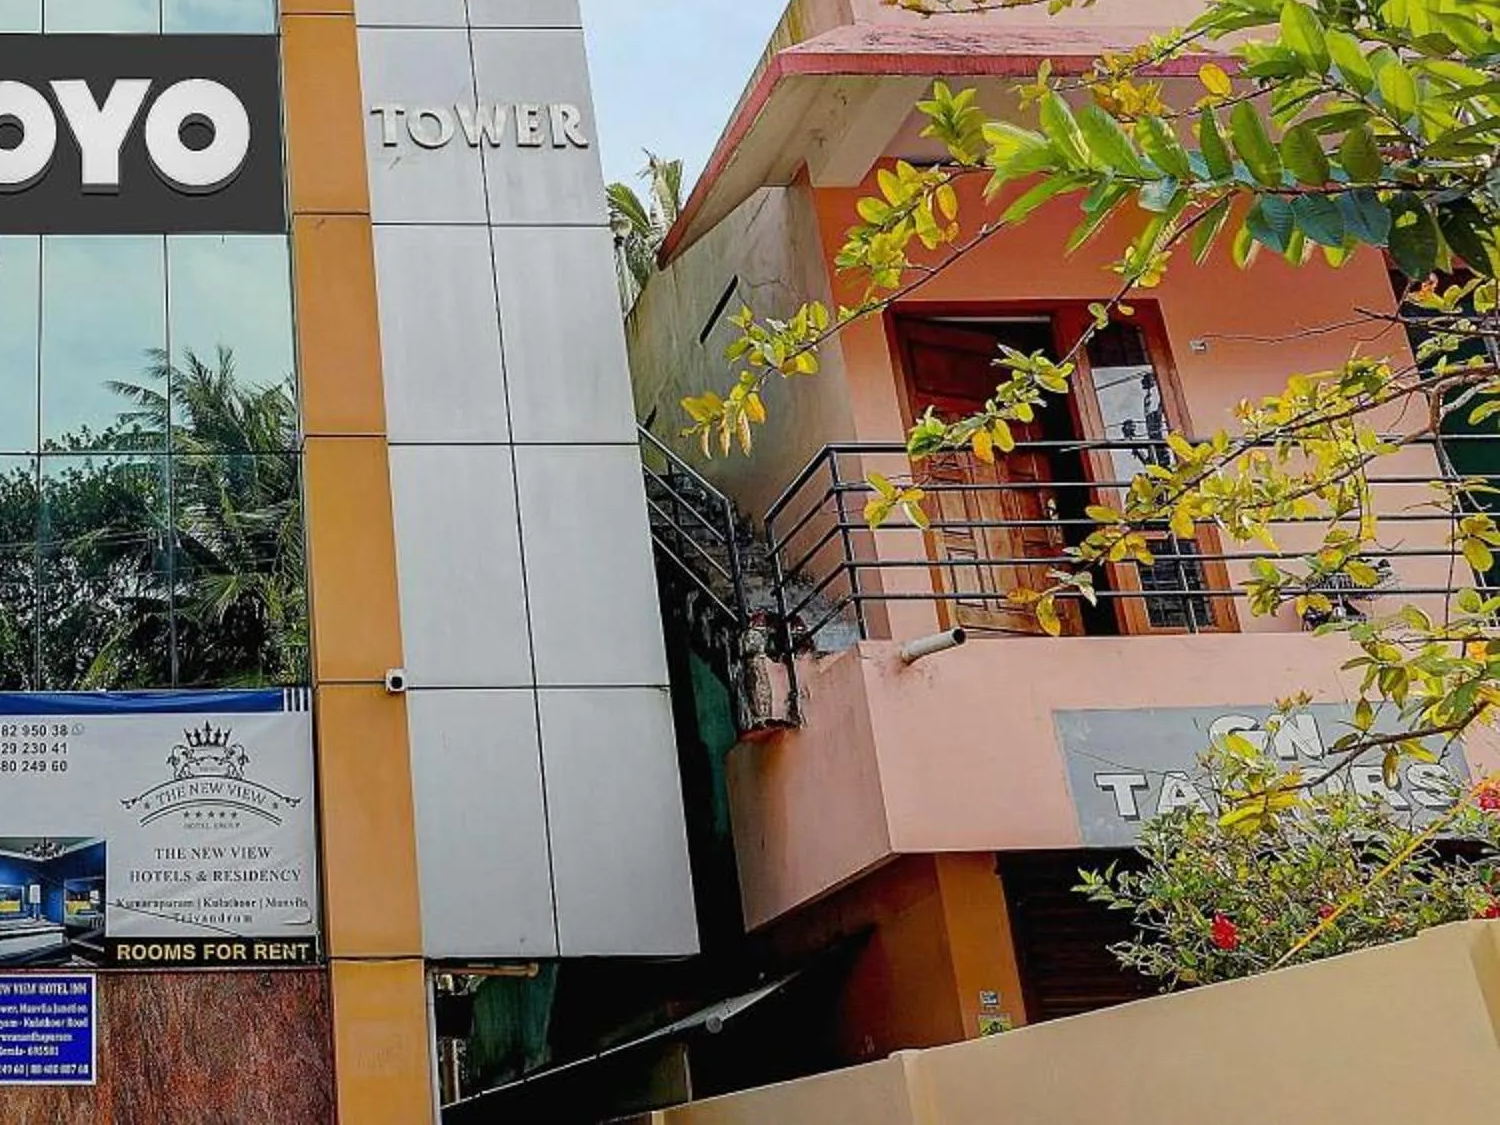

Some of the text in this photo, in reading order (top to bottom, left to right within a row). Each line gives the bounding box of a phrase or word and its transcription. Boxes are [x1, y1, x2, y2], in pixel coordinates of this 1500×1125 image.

[370, 103, 590, 150] TOWER
[21, 724, 47, 737] 950
[51, 724, 68, 737] 38
[21, 742, 47, 754] 230
[51, 742, 67, 754] 41
[21, 760, 47, 772] 249
[51, 760, 68, 772] 60
[156, 782, 267, 805] THE NEW VIEW
[155, 846, 273, 860] THE NEW VIEW
[130, 869, 301, 883] HOTELS & RESIDENCY
[117, 943, 310, 960] ROOMS FOR RENT
